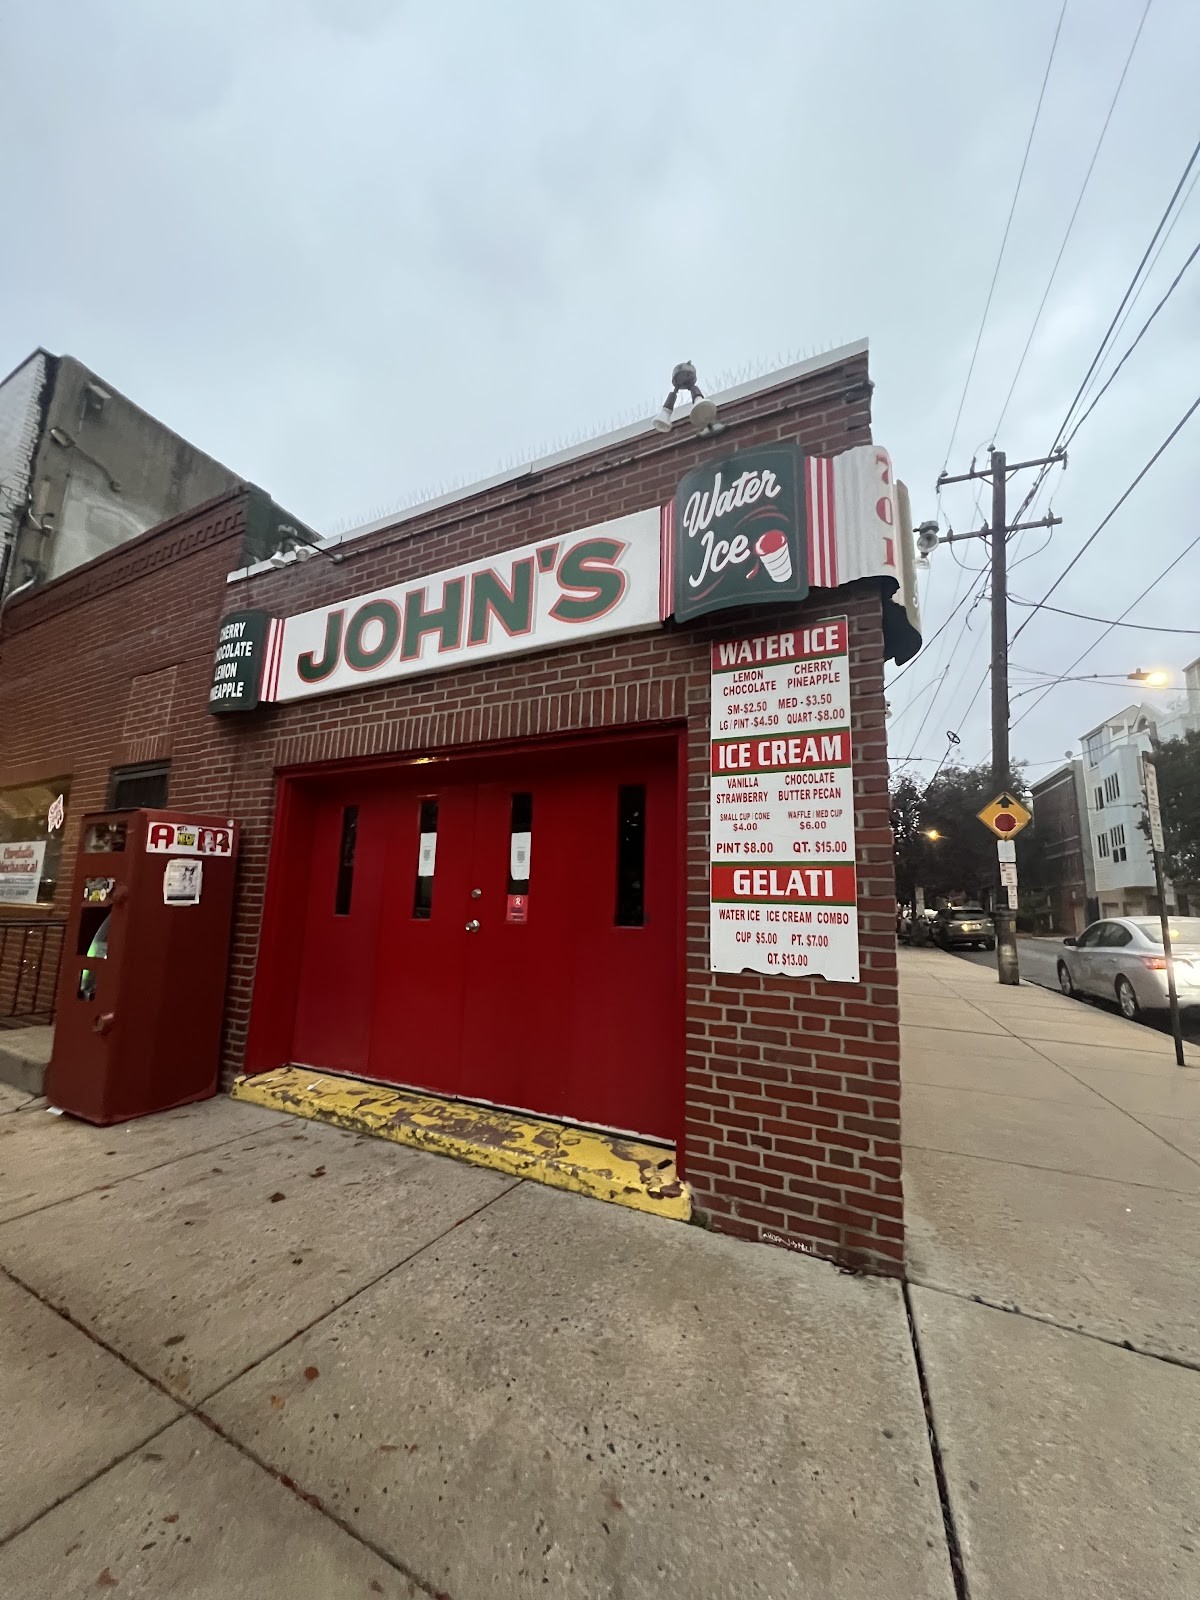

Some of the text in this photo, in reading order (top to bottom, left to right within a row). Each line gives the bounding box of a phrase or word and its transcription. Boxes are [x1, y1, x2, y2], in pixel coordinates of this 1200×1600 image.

[683, 469, 781, 537] Water
[688, 531, 750, 587] Ice
[297, 537, 627, 683] JOHN'S
[719, 625, 840, 666] WATER ICE
[214, 662, 238, 681] LEMON
[794, 660, 833, 675] CHERRY
[733, 669, 764, 683] LEMON
[787, 672, 840, 688] PINEAPPLE
[723, 680, 777, 696] CHOCOLATE
[778, 697, 798, 709] MED
[806, 693, 832, 707] $3.50
[720, 720, 728, 731] LG
[733, 718, 749, 729] PINT
[787, 711, 812, 724] QUART
[719, 735, 842, 769] ICE CREAM
[727, 777, 759, 789] VANILLA
[785, 772, 835, 785] CHOCOLATE
[716, 791, 768, 804] STRAWBERRY
[778, 787, 841, 801] BUTTER PECAN
[720, 812, 738, 821] SMALL
[739, 812, 751, 820] CUP
[755, 812, 770, 820] CONE
[788, 810, 811, 819] WAFFLE
[816, 810, 829, 818] MED
[830, 809, 843, 818] CUP
[733, 822, 758, 832] $4.00
[799, 820, 827, 830] $6.00
[716, 842, 773, 854] PINT $8.00
[793, 841, 847, 853] QT. $15.00
[733, 869, 834, 896] GELATI
[719, 909, 849, 925] WATER ICE ICE CREAM COMBO
[735, 931, 828, 947] CUP $5.00 PT. $7.00
[767, 952, 808, 967] QT. $13.00
